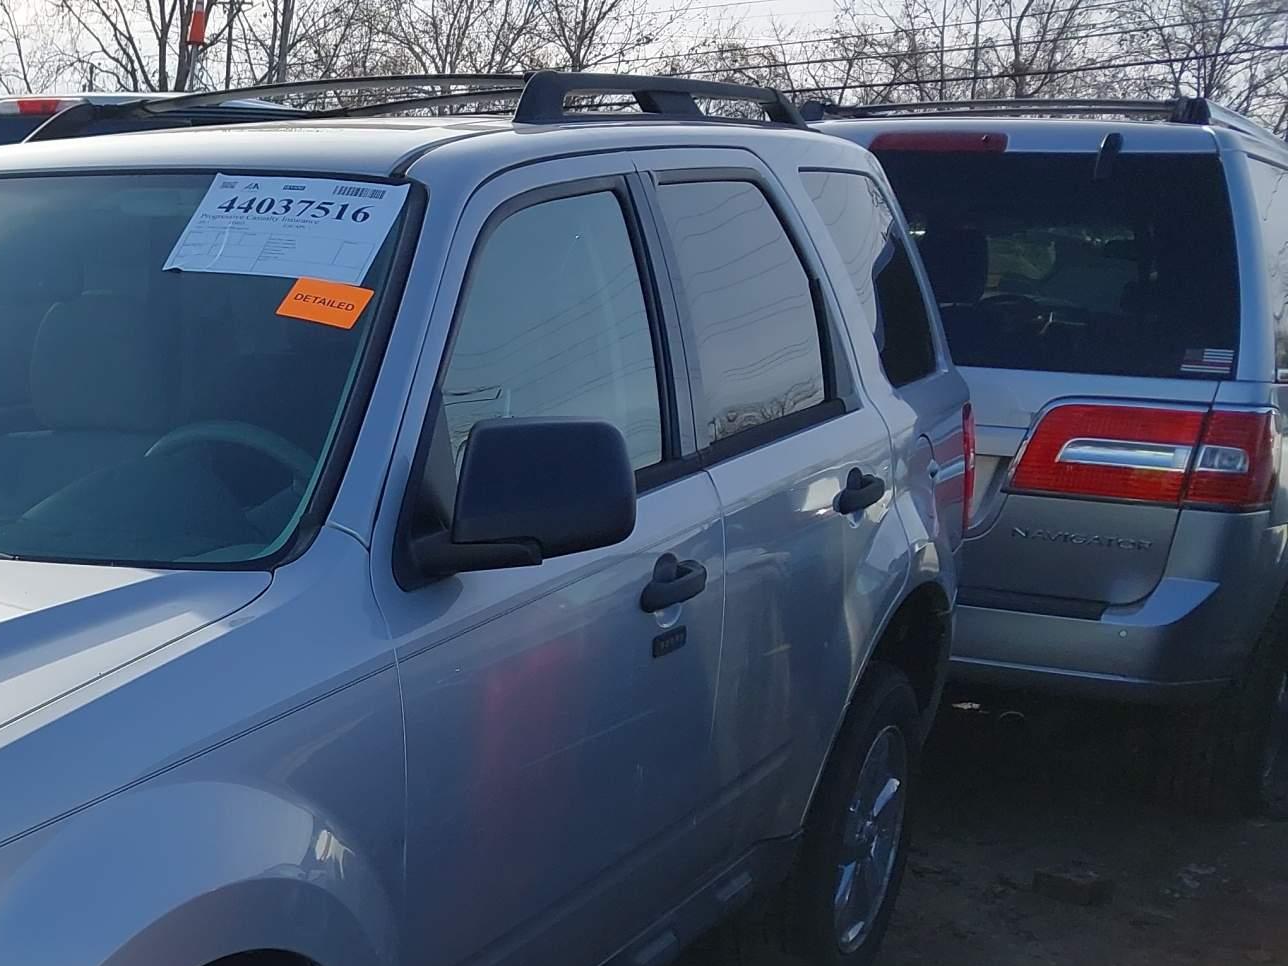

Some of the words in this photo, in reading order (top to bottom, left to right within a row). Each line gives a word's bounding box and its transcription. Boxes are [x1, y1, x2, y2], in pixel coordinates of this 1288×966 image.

[217, 196, 375, 223] 44037516
[294, 292, 355, 312] DETAILED
[1012, 527, 1152, 550] NAVIGATOR
